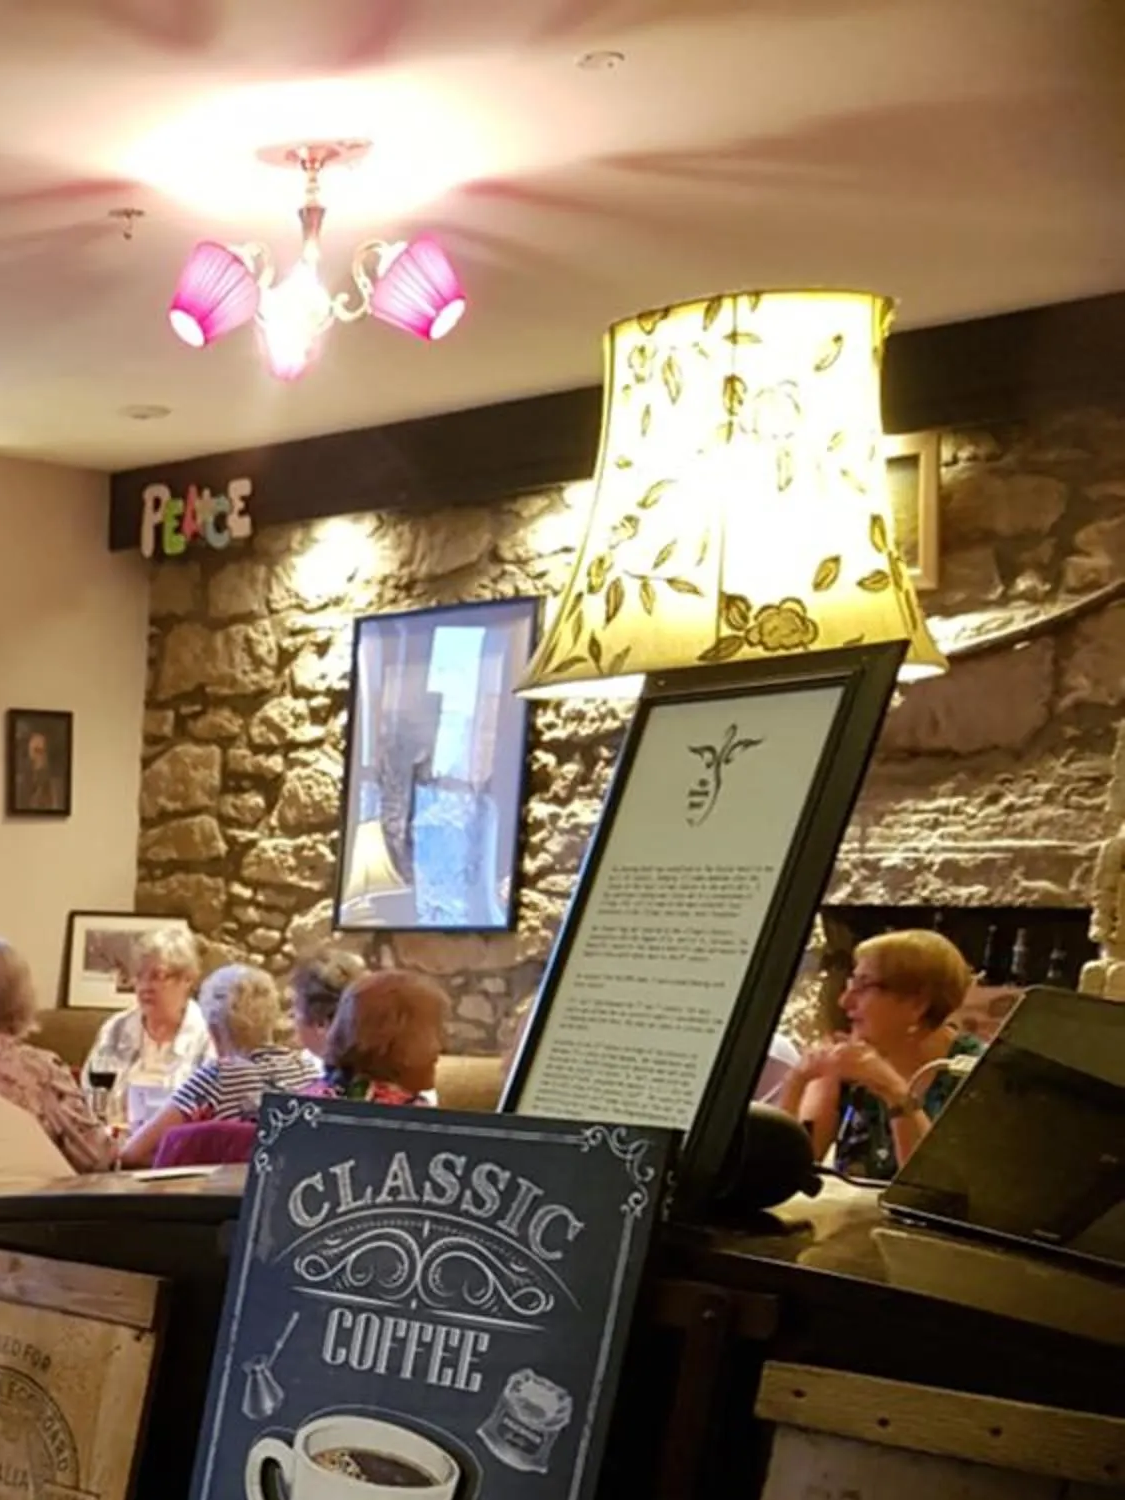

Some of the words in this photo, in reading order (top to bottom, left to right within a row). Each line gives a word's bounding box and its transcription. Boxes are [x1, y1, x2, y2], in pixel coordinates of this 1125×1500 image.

[141, 477, 252, 558] PEACE
[287, 1150, 585, 1262] CLASSIC
[321, 1306, 492, 1393] COFFEE
